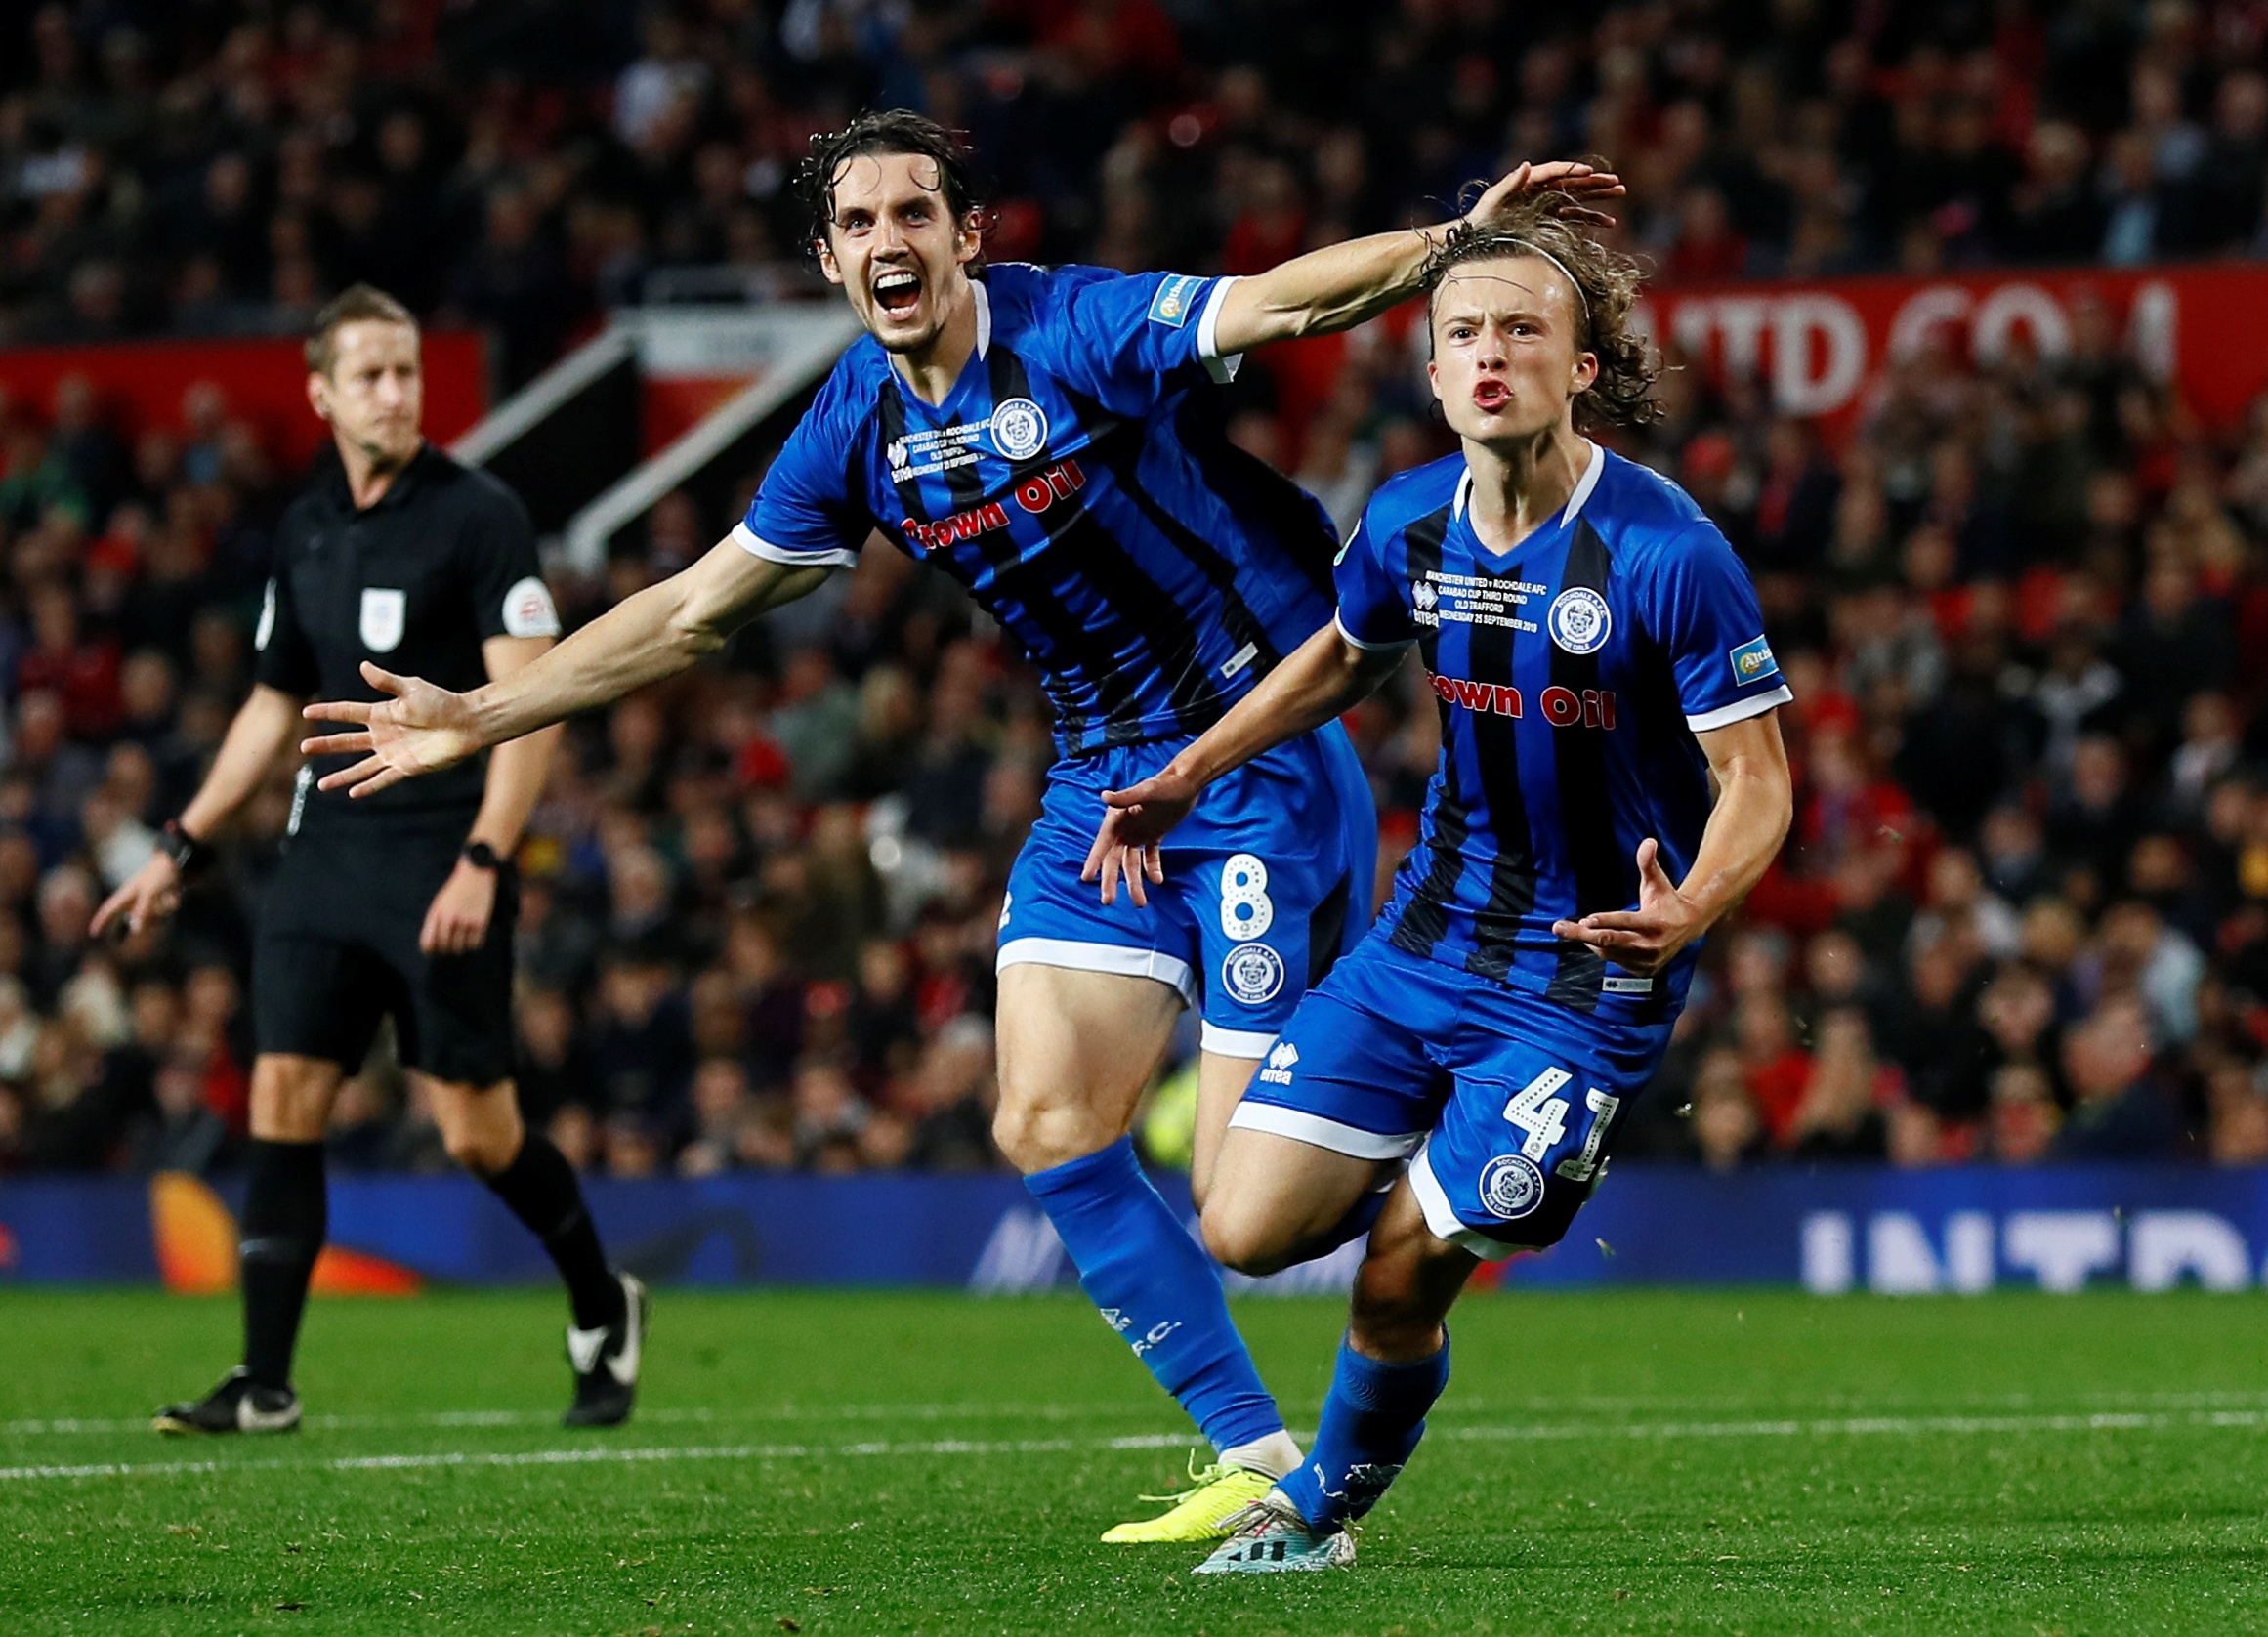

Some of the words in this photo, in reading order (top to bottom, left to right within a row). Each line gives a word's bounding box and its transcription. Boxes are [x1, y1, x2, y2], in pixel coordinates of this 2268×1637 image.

[1015, 459, 1086, 514] Oil
[1454, 599, 1469, 609] OLD
[1492, 578, 1532, 594] ROCHDALE
[1531, 583, 1547, 595] AFC
[1540, 686, 1616, 730] Oil
[1221, 853, 1273, 941] 8
[1503, 1066, 1619, 1181] 41
